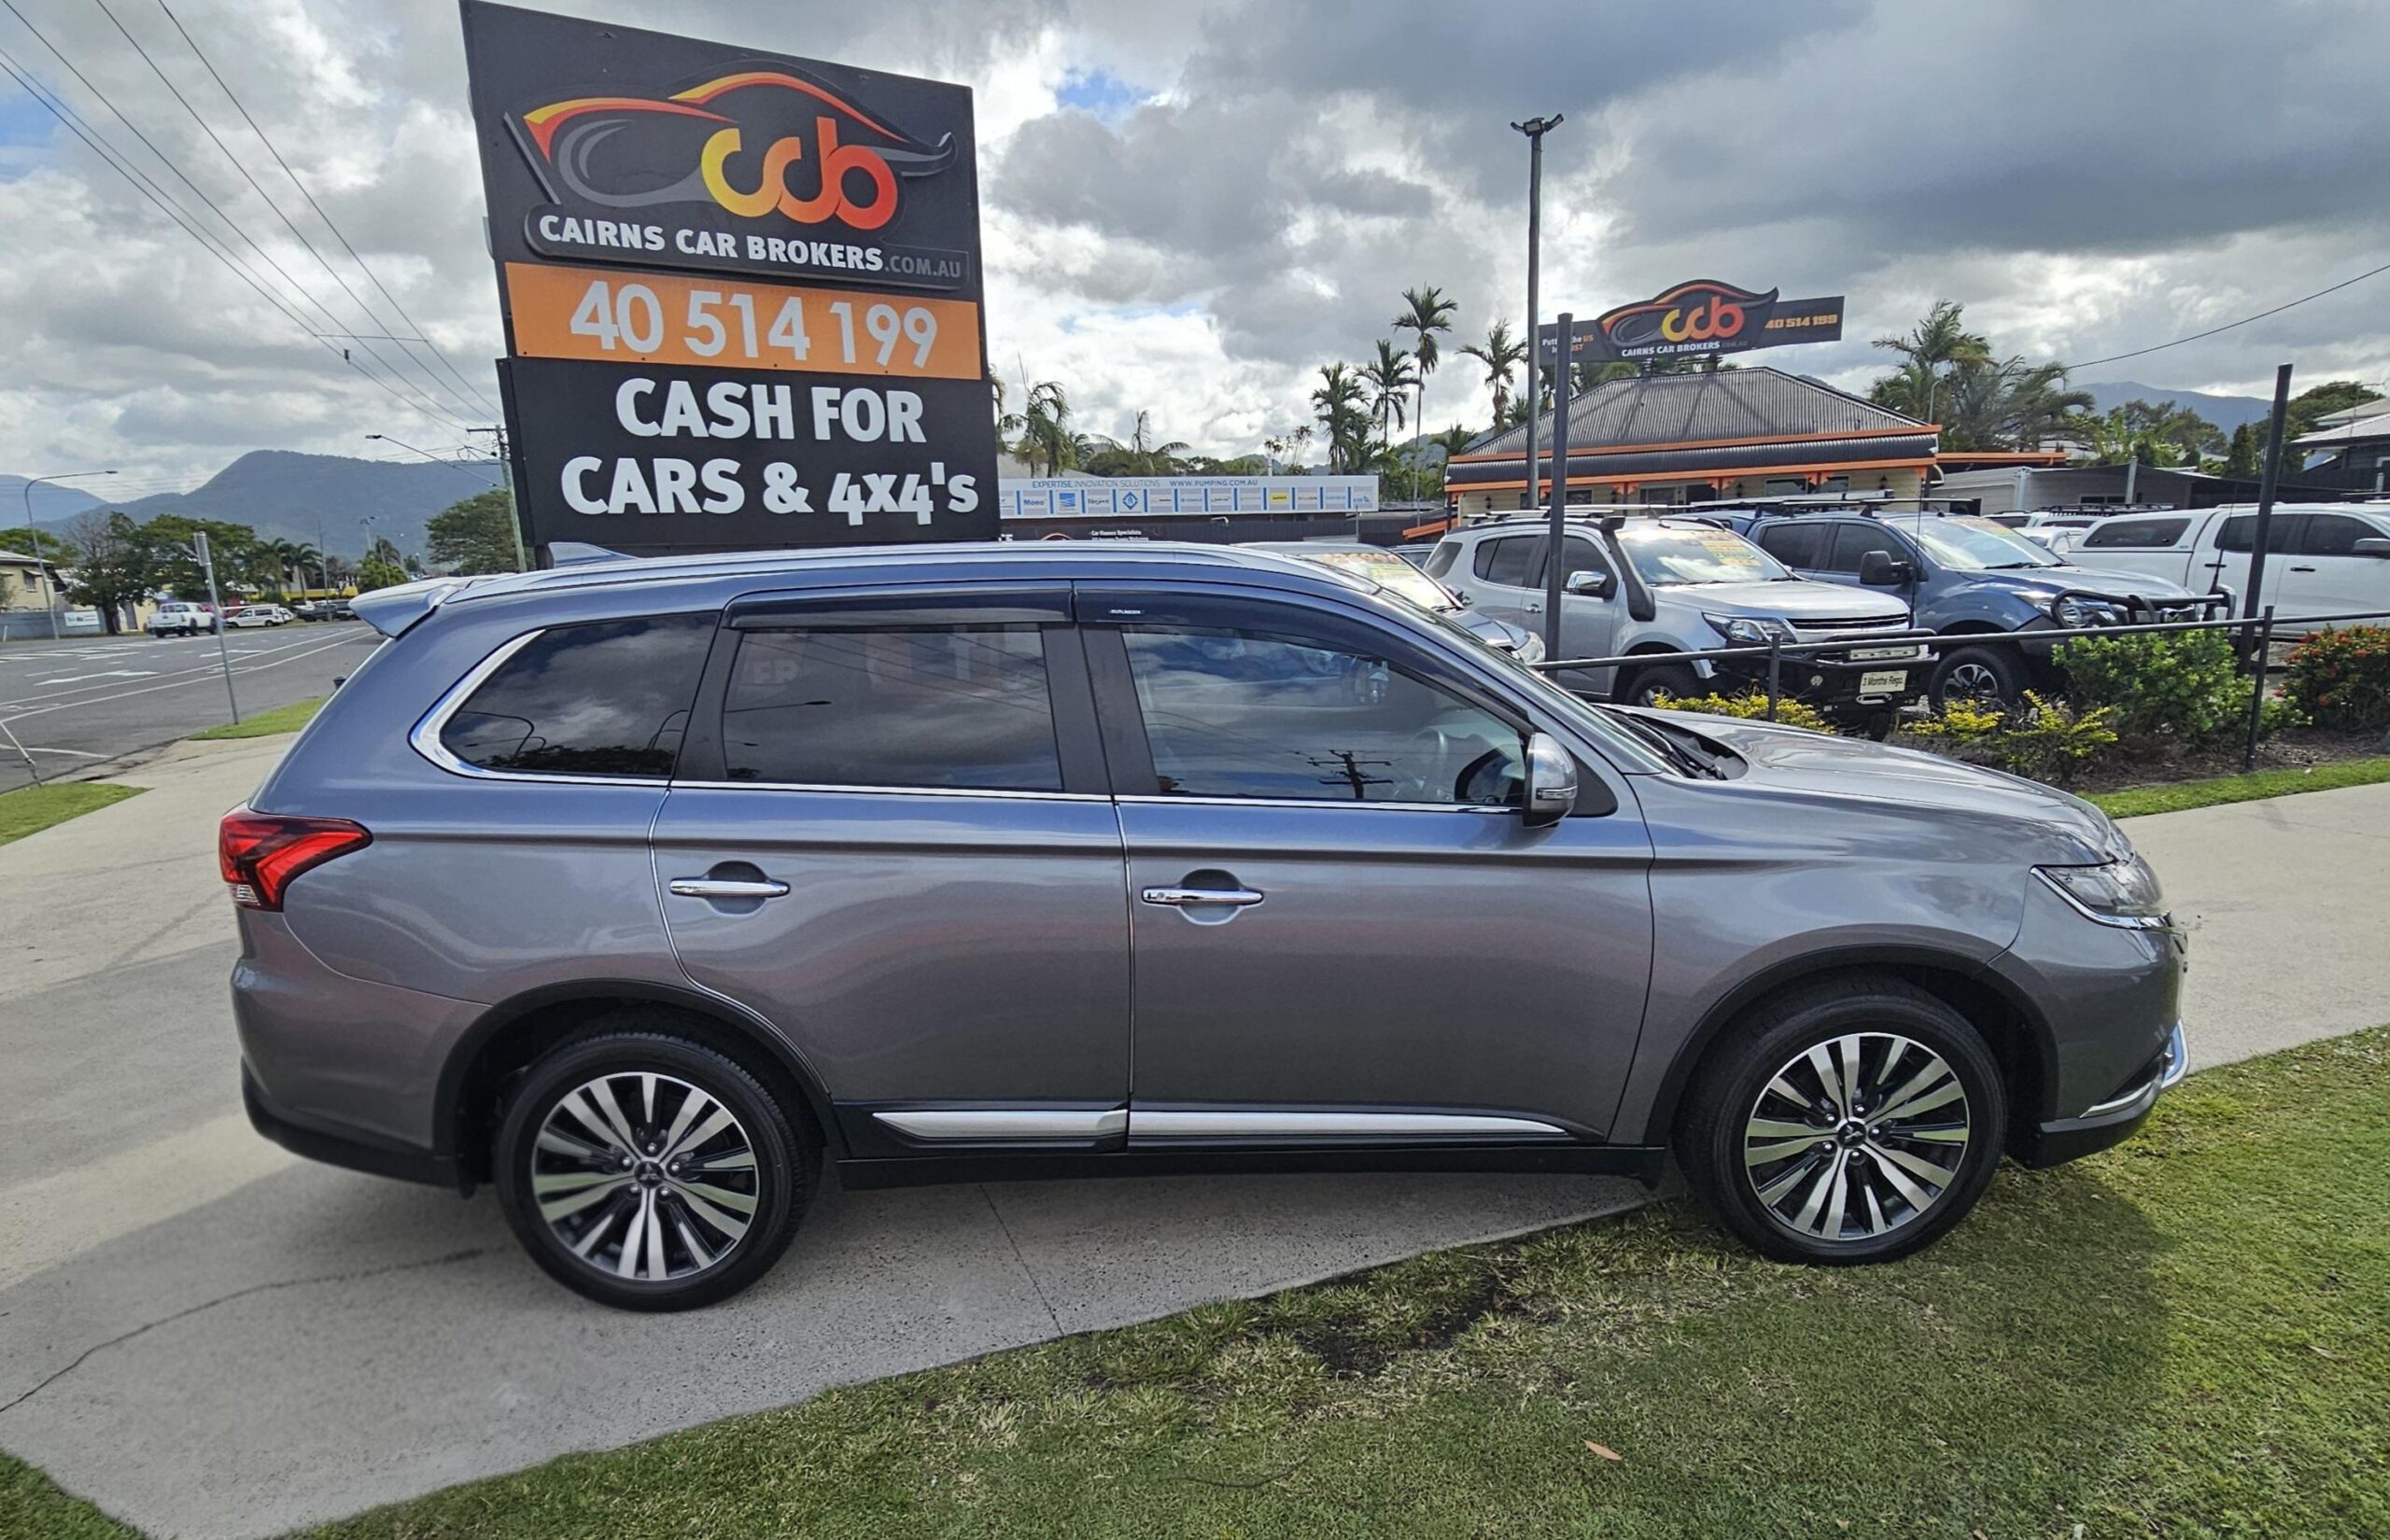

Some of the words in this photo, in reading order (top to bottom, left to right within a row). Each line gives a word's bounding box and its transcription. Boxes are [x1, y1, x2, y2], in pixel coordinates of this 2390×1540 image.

[539, 215, 664, 251] CAIRNS
[676, 229, 738, 259] CAR
[569, 280, 665, 353] 40
[683, 290, 811, 361] 514
[829, 301, 938, 370] 199
[1764, 319, 1784, 329] 40
[1785, 316, 1810, 328] 514
[1622, 346, 1654, 357] CAIRNS
[1656, 345, 1675, 355] CAR
[615, 377, 795, 441] CASH
[811, 386, 927, 443] FOR
[561, 455, 746, 515] CARS
[763, 462, 814, 514] &
[1120, 479, 1161, 488] SOLUTIONS
[1169, 479, 1258, 487] WWW.PUMPING.COM.AU
[1867, 677, 1888, 686] Months
